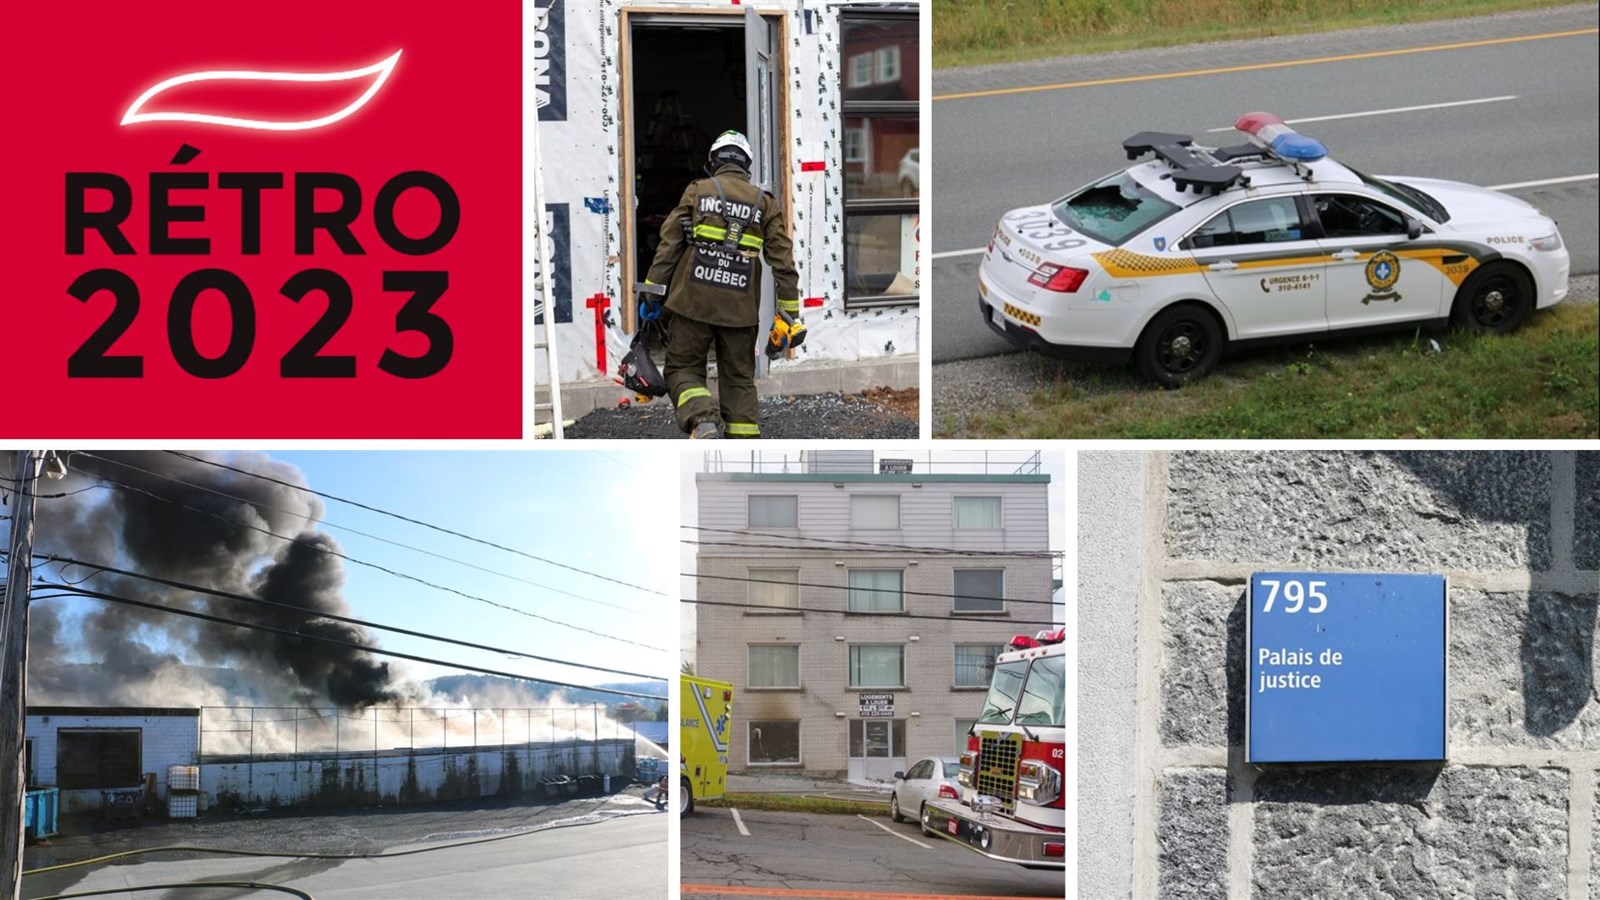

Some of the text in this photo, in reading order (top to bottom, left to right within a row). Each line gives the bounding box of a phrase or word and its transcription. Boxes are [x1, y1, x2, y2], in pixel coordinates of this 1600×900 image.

[701, 198, 762, 223] INCENDE
[1004, 211, 1087, 251] 3039
[1486, 235, 1524, 245] POLICE
[718, 258, 730, 268] DU
[694, 265, 747, 288] QUÉBEC
[1269, 275, 1300, 285] URGENCE
[1278, 282, 1311, 292] 310-4141
[1260, 580, 1328, 613] 795
[1259, 648, 1343, 665] Palais de
[1258, 671, 1321, 693] justice
[680, 718, 700, 728] LANCE
[1052, 748, 1064, 759] 02
